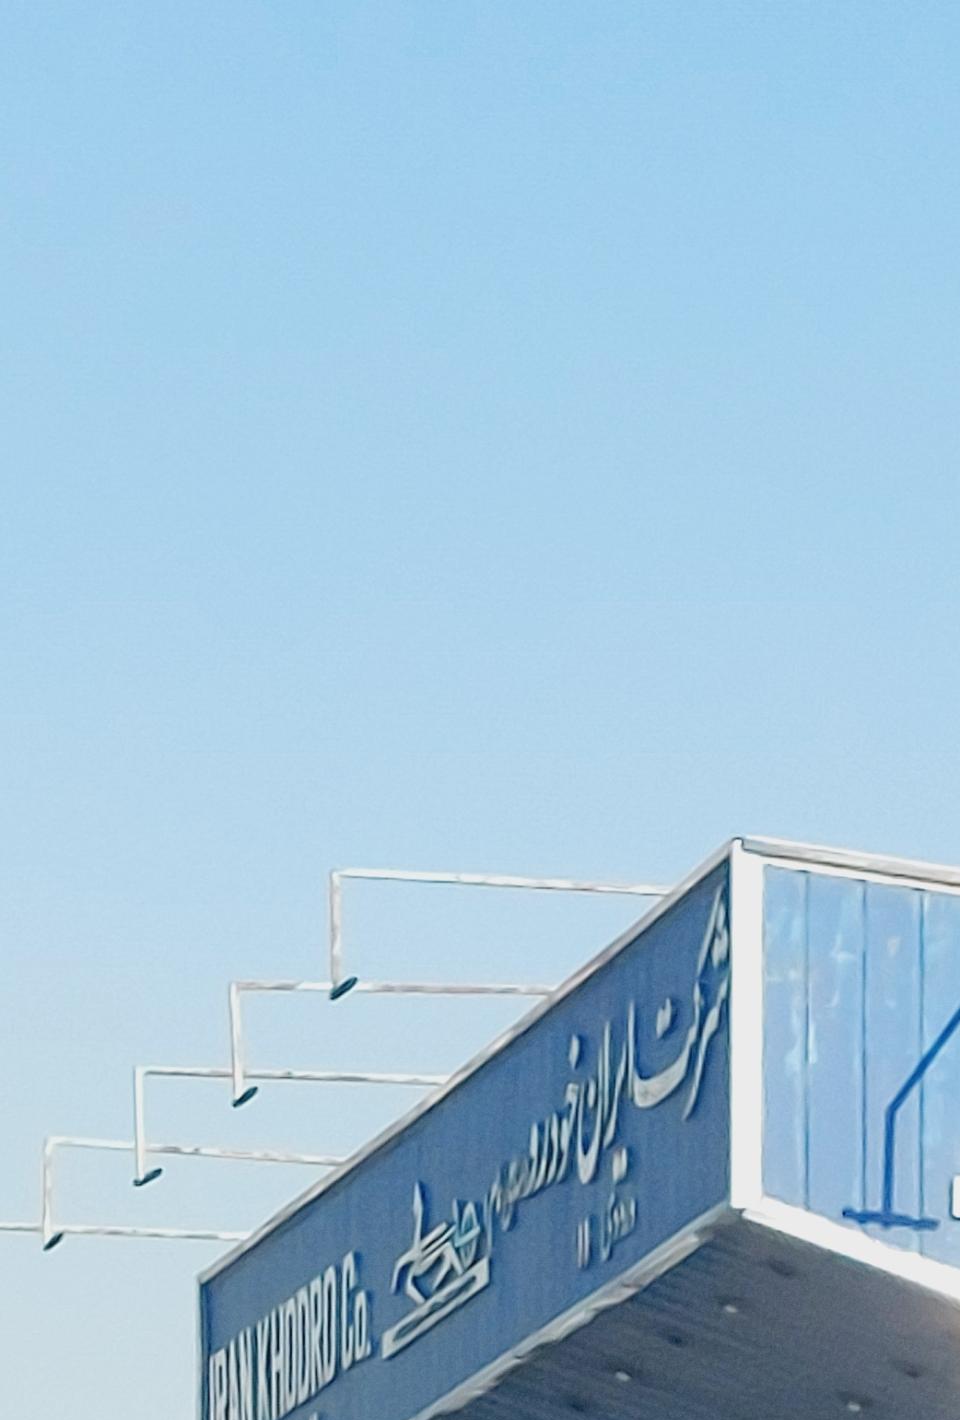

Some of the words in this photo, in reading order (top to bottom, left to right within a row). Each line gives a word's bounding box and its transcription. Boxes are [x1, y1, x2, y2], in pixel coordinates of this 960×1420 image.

[633, 882, 729, 1122] شرکت
[522, 1034, 580, 1199] خودرو
[577, 1000, 636, 1184] ایران
[341, 1250, 372, 1371] Co.
